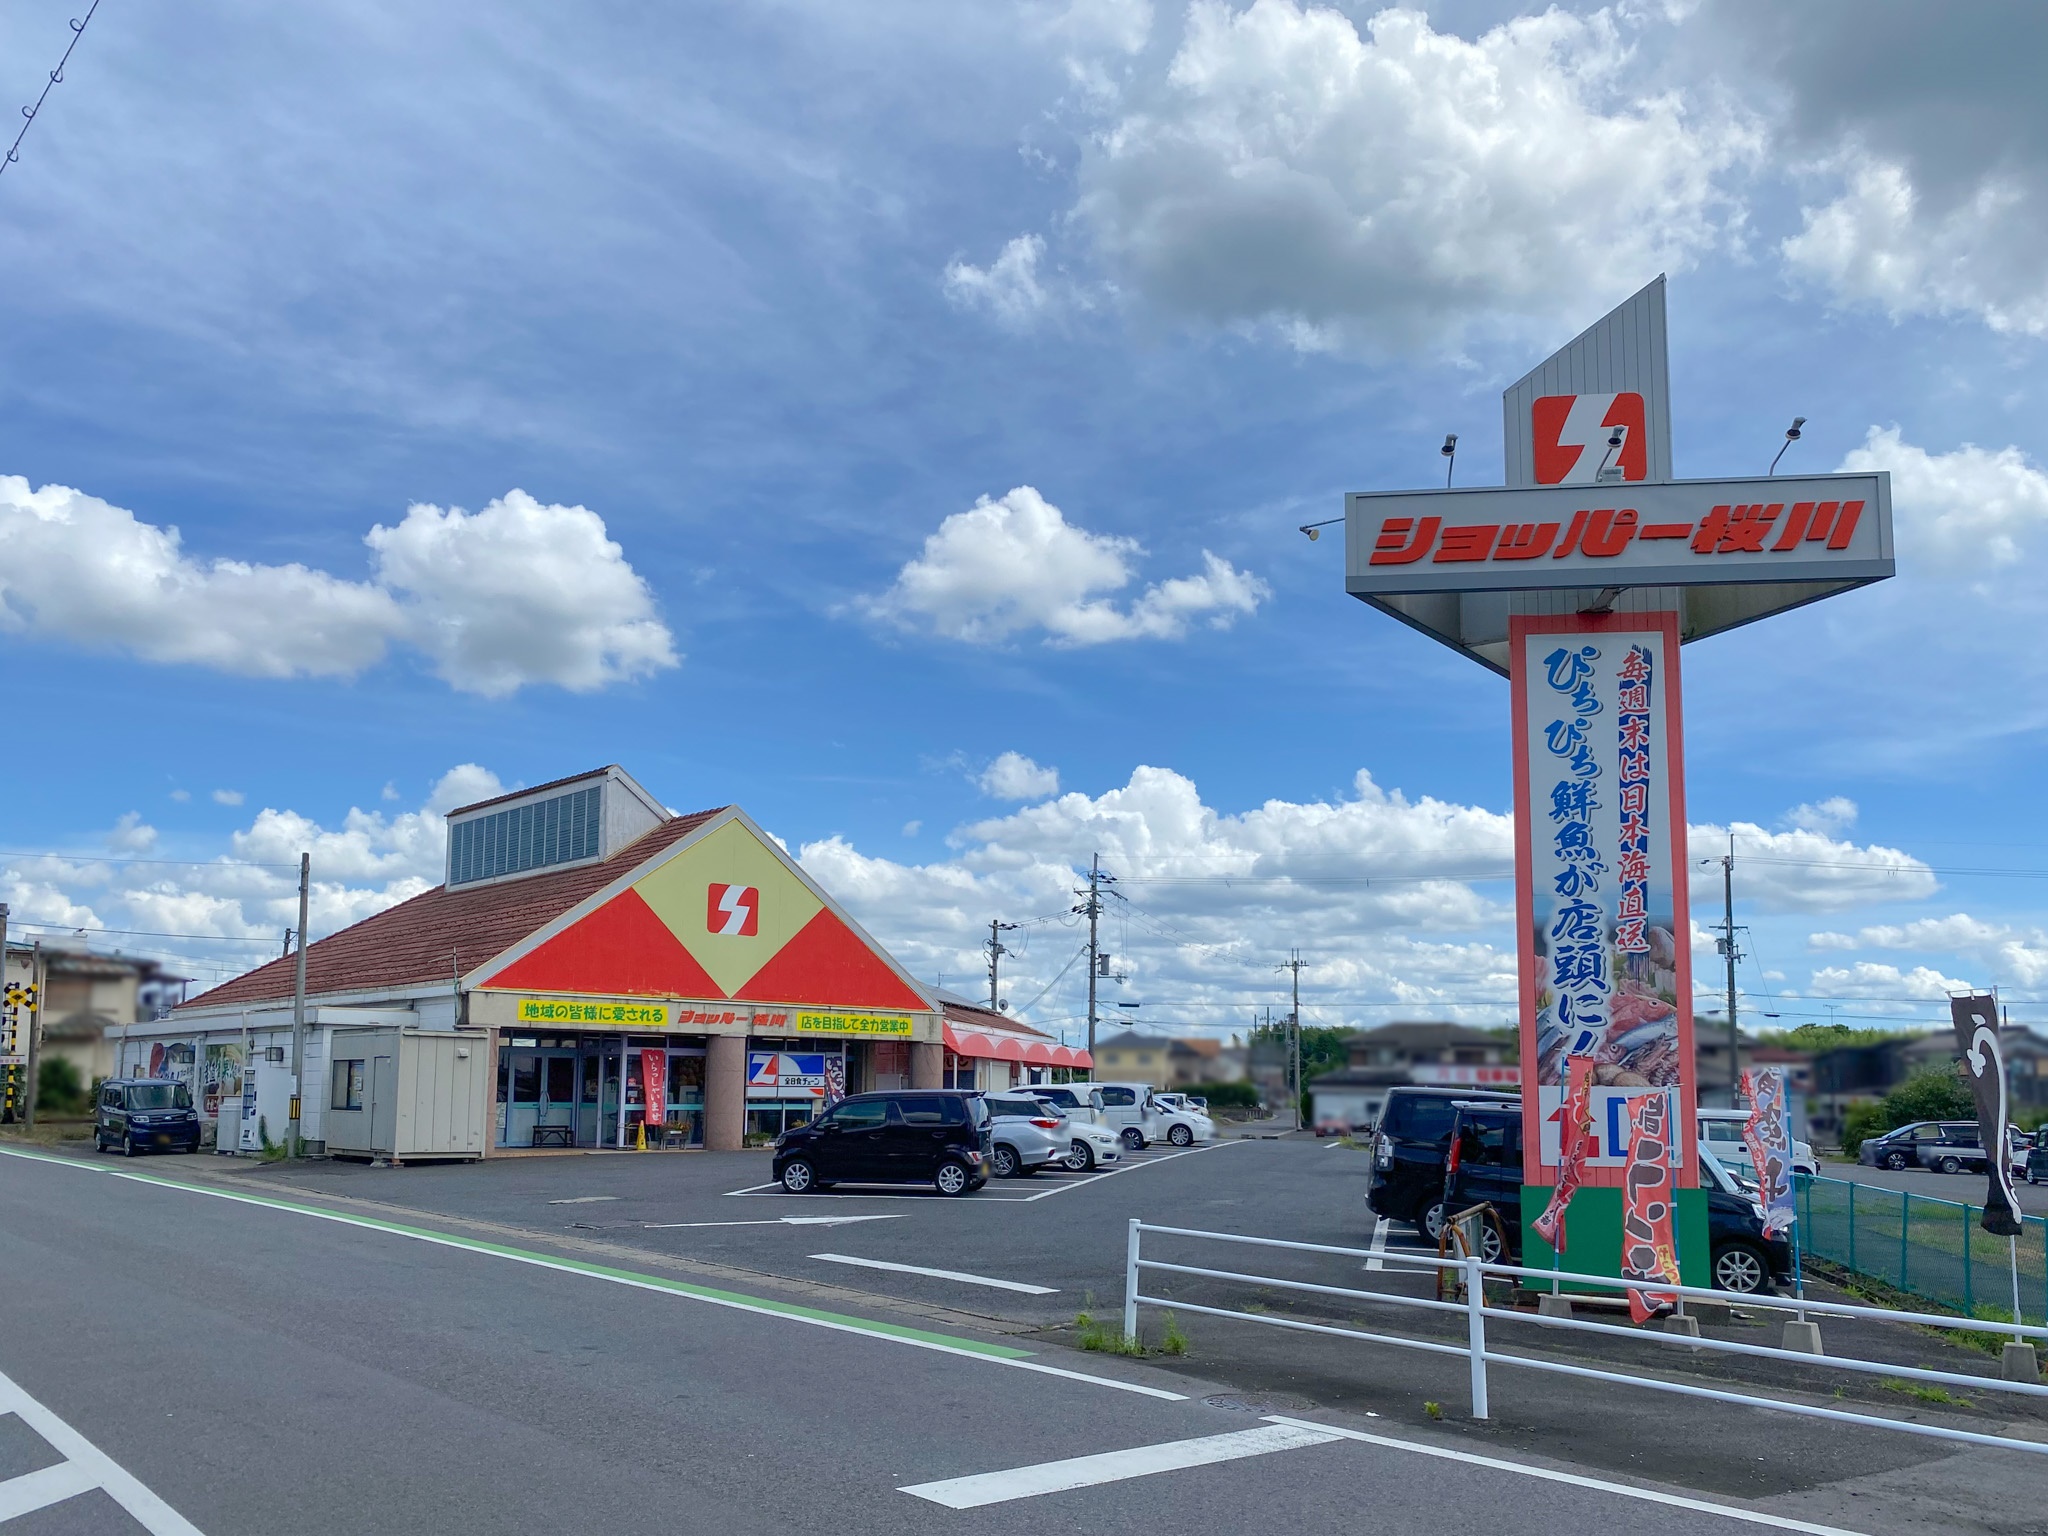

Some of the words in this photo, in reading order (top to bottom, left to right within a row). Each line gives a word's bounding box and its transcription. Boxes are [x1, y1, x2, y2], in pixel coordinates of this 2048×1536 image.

[1369, 499, 1866, 566] ショッパー桜川
[1616, 650, 1651, 953] 毎週末は日本海直送
[524, 1003, 663, 1023] 地域の皆様に愛される
[801, 1016, 909, 1033] 店を目指して全力営業中
[648, 1054, 662, 1121] いらっしゃいませ
[784, 1076, 820, 1086] 全日食チェーン
